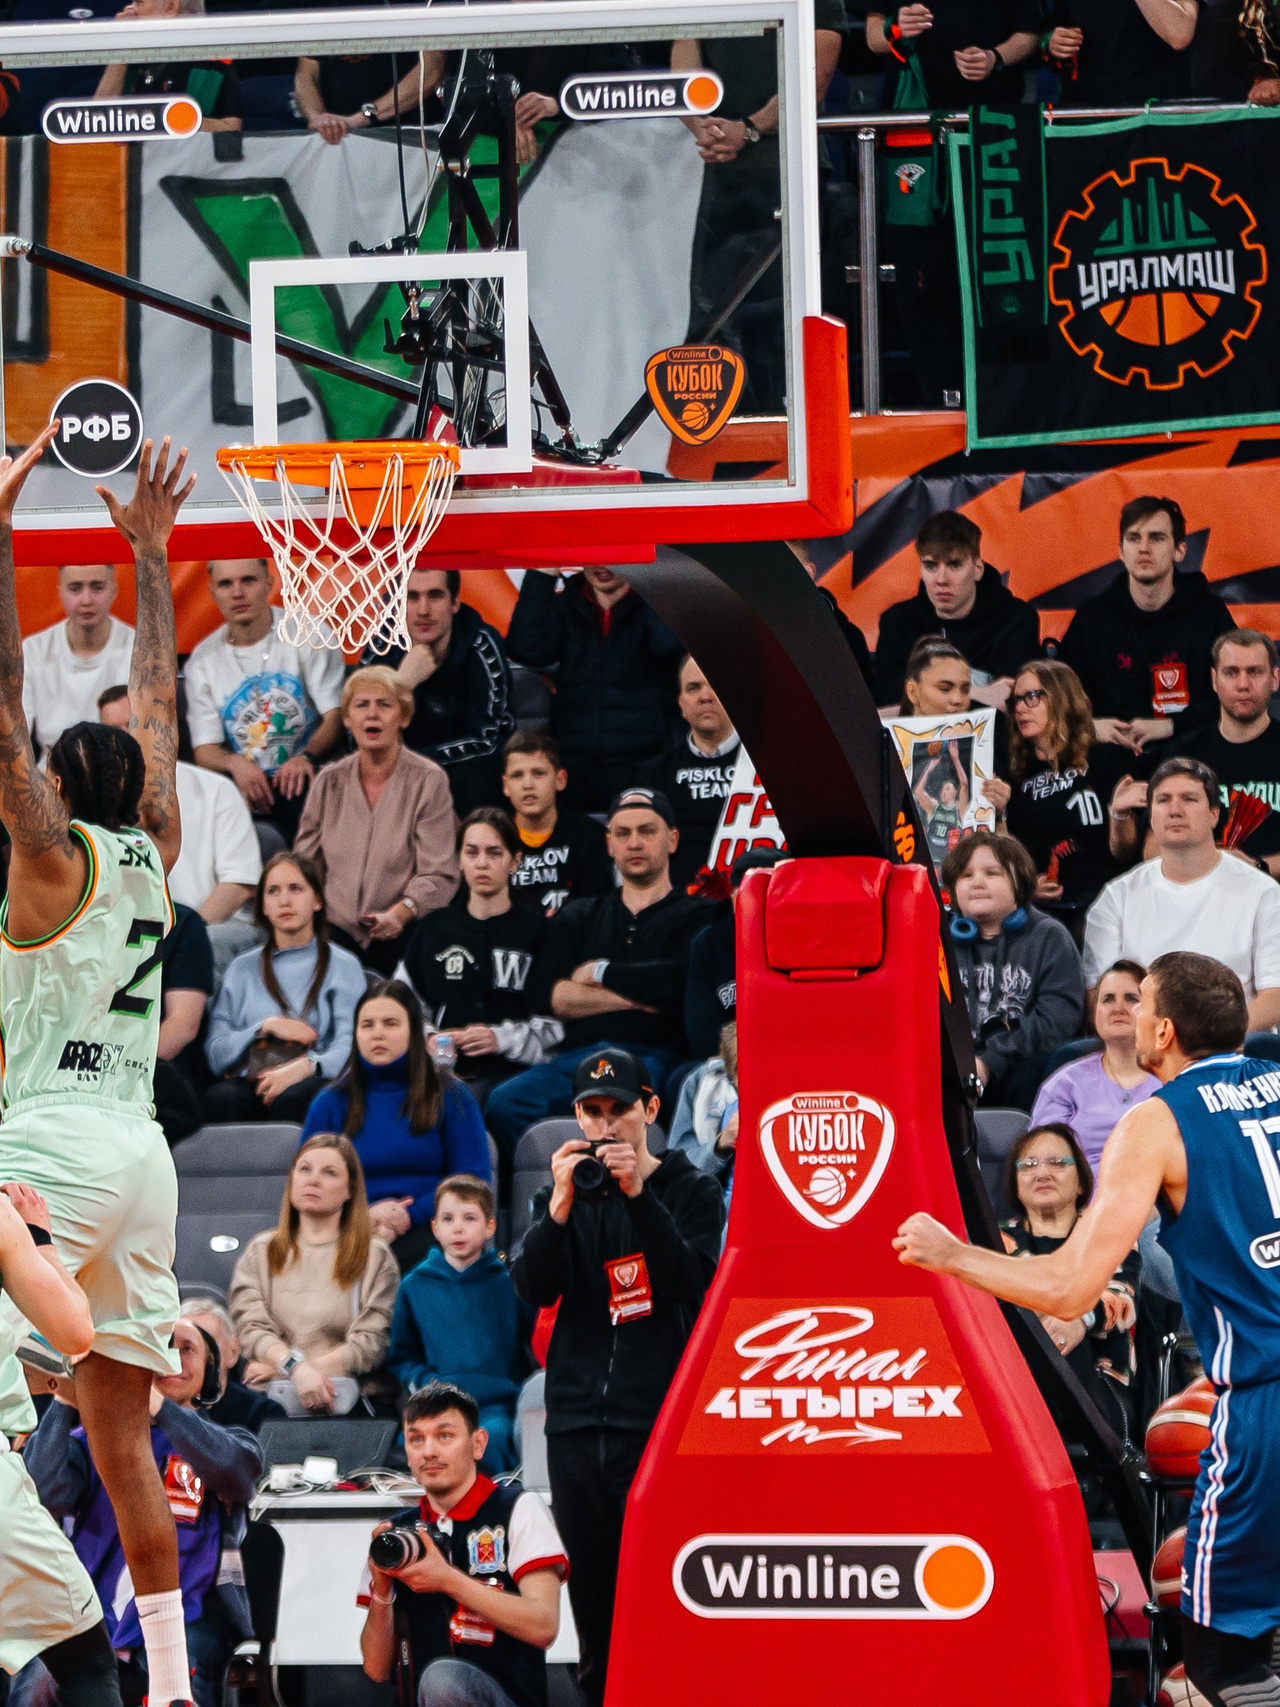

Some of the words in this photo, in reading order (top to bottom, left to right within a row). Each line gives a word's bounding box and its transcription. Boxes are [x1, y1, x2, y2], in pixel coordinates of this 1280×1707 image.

[575, 83, 677, 111] Winline
[56, 108, 156, 134] Winline
[1077, 249, 1237, 311] УРАЛМАШ
[671, 350, 707, 360] Winline
[666, 363, 723, 393] КУБОК
[673, 392, 718, 401] РОССИИ
[62, 414, 131, 443] РФБ
[676, 765, 737, 785] PISKLO
[1032, 778, 1074, 801] TEAM
[1065, 789, 1104, 826] 10
[510, 868, 559, 886] TEAM
[108, 918, 164, 1018] 2
[492, 948, 533, 991] W
[795, 1097, 841, 1109] Winline
[788, 1113, 866, 1152] КУБОК
[797, 1153, 857, 1165] РОССИИ
[734, 1305, 928, 1384] Финал
[704, 1385, 963, 1420] 4ЕТЫРЕХ
[702, 1553, 901, 1600] Winline
